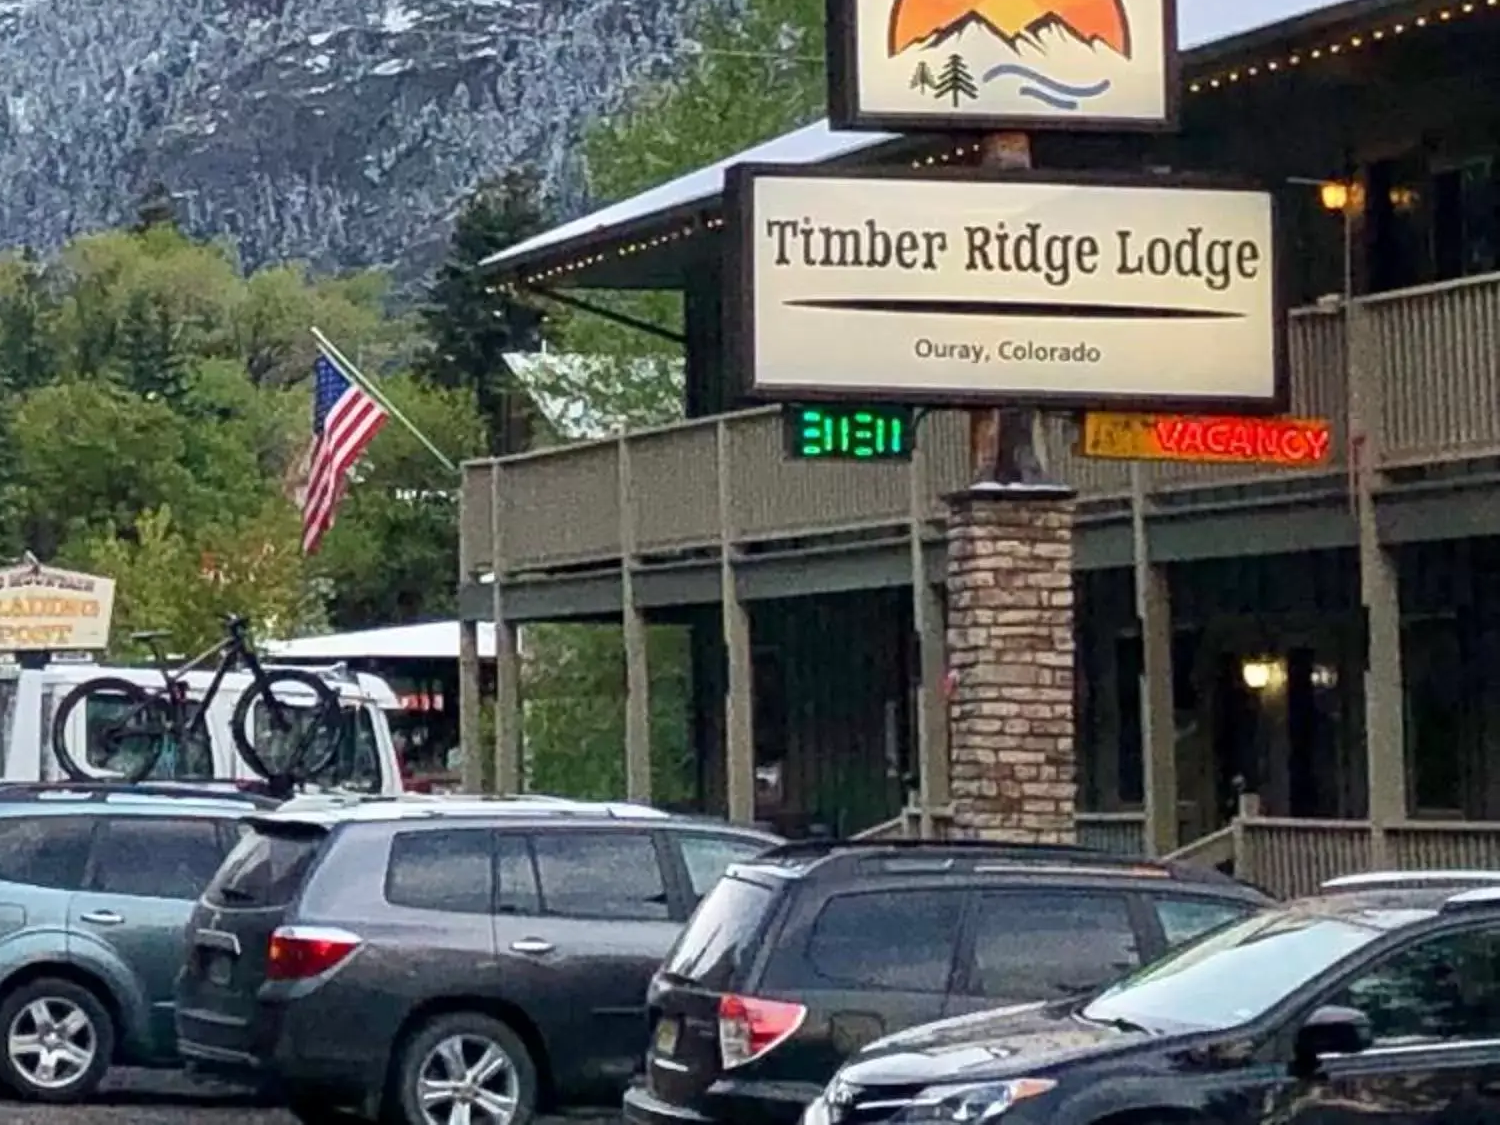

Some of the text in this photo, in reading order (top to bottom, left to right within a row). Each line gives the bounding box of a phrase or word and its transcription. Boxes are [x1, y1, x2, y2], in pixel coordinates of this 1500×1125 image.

[766, 217, 1260, 291] Timber Ridge Lodge
[914, 338, 1101, 363] Ouray, Colorado
[1156, 421, 1329, 460] VACANCY
